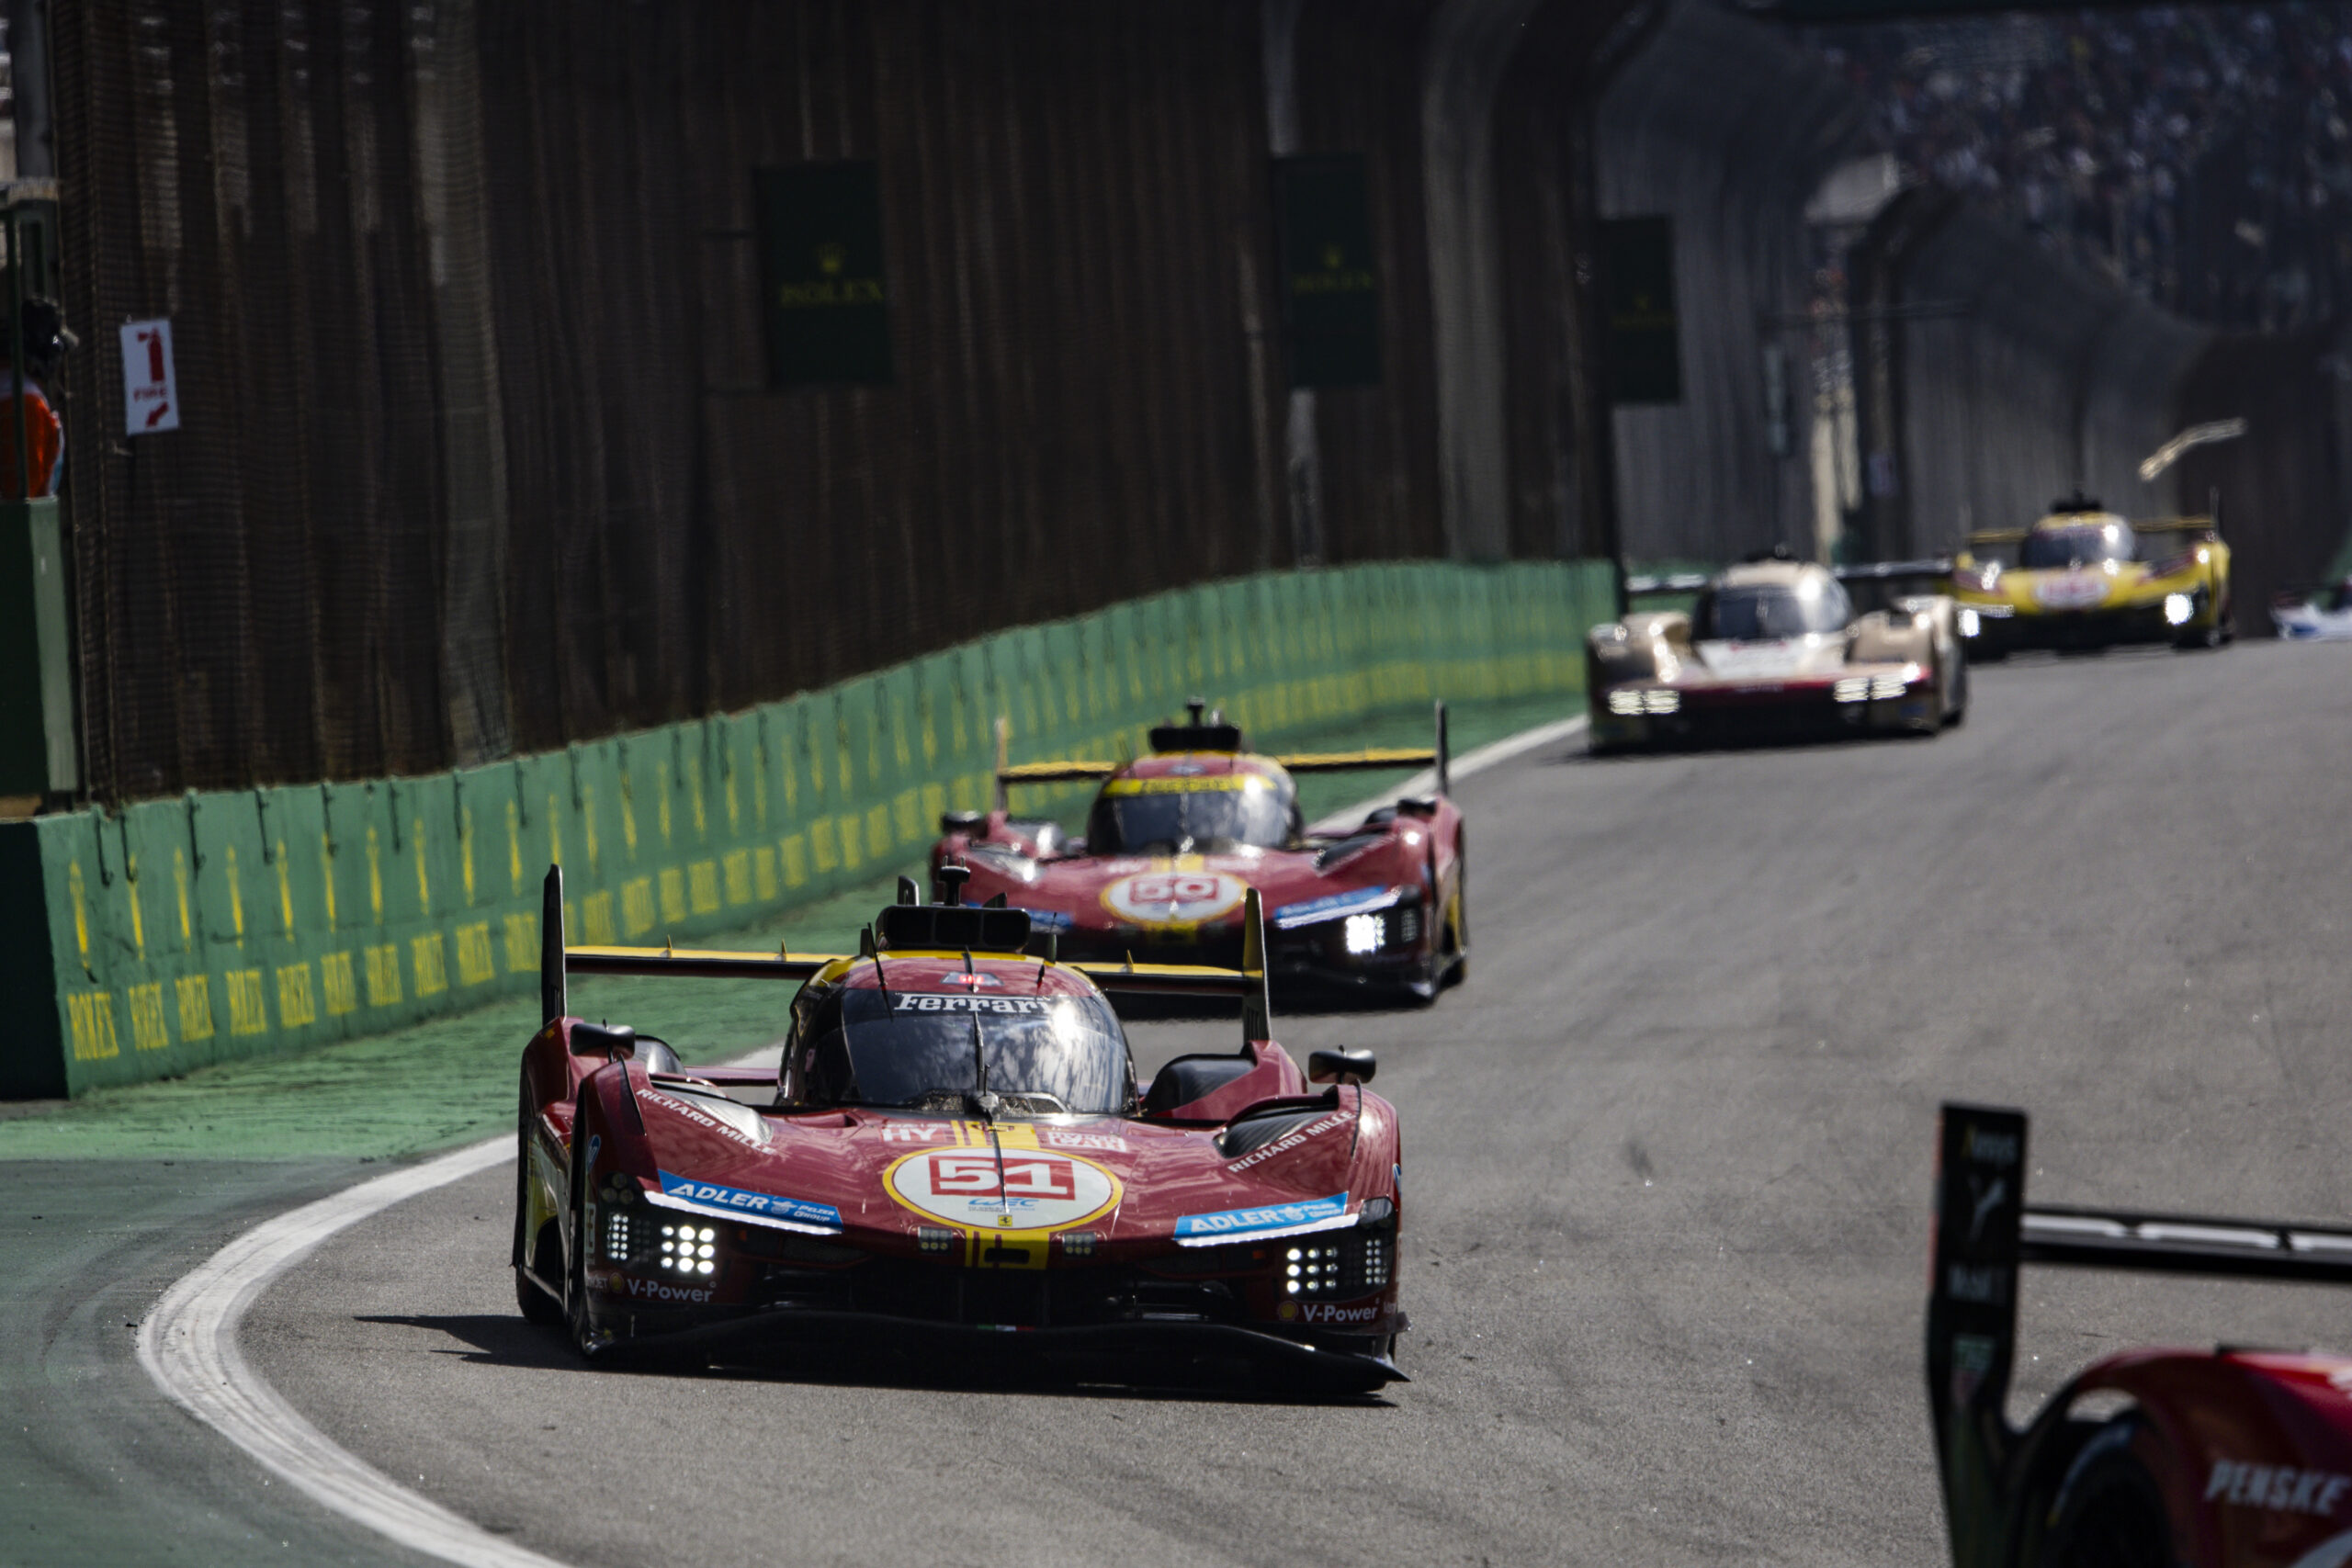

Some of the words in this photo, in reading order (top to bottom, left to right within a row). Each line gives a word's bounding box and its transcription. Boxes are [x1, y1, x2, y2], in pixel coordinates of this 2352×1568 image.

[894, 993, 1052, 1014] Ferrari
[636, 1089, 717, 1128] RICHARD
[716, 1125, 777, 1155] MILLE
[1227, 1134, 1307, 1173] RICHARD
[1306, 1111, 1356, 1137] MILLE
[937, 1159, 1068, 1194] 51
[668, 1182, 770, 1211] ADLER
[797, 1204, 836, 1217] PELZER
[793, 1210, 831, 1223] GROUP
[1191, 1209, 1284, 1233] ADLER
[627, 1278, 714, 1303] V-Power
[1302, 1304, 1378, 1322] V-Power
[2203, 1459, 2351, 1517] PENSKE
